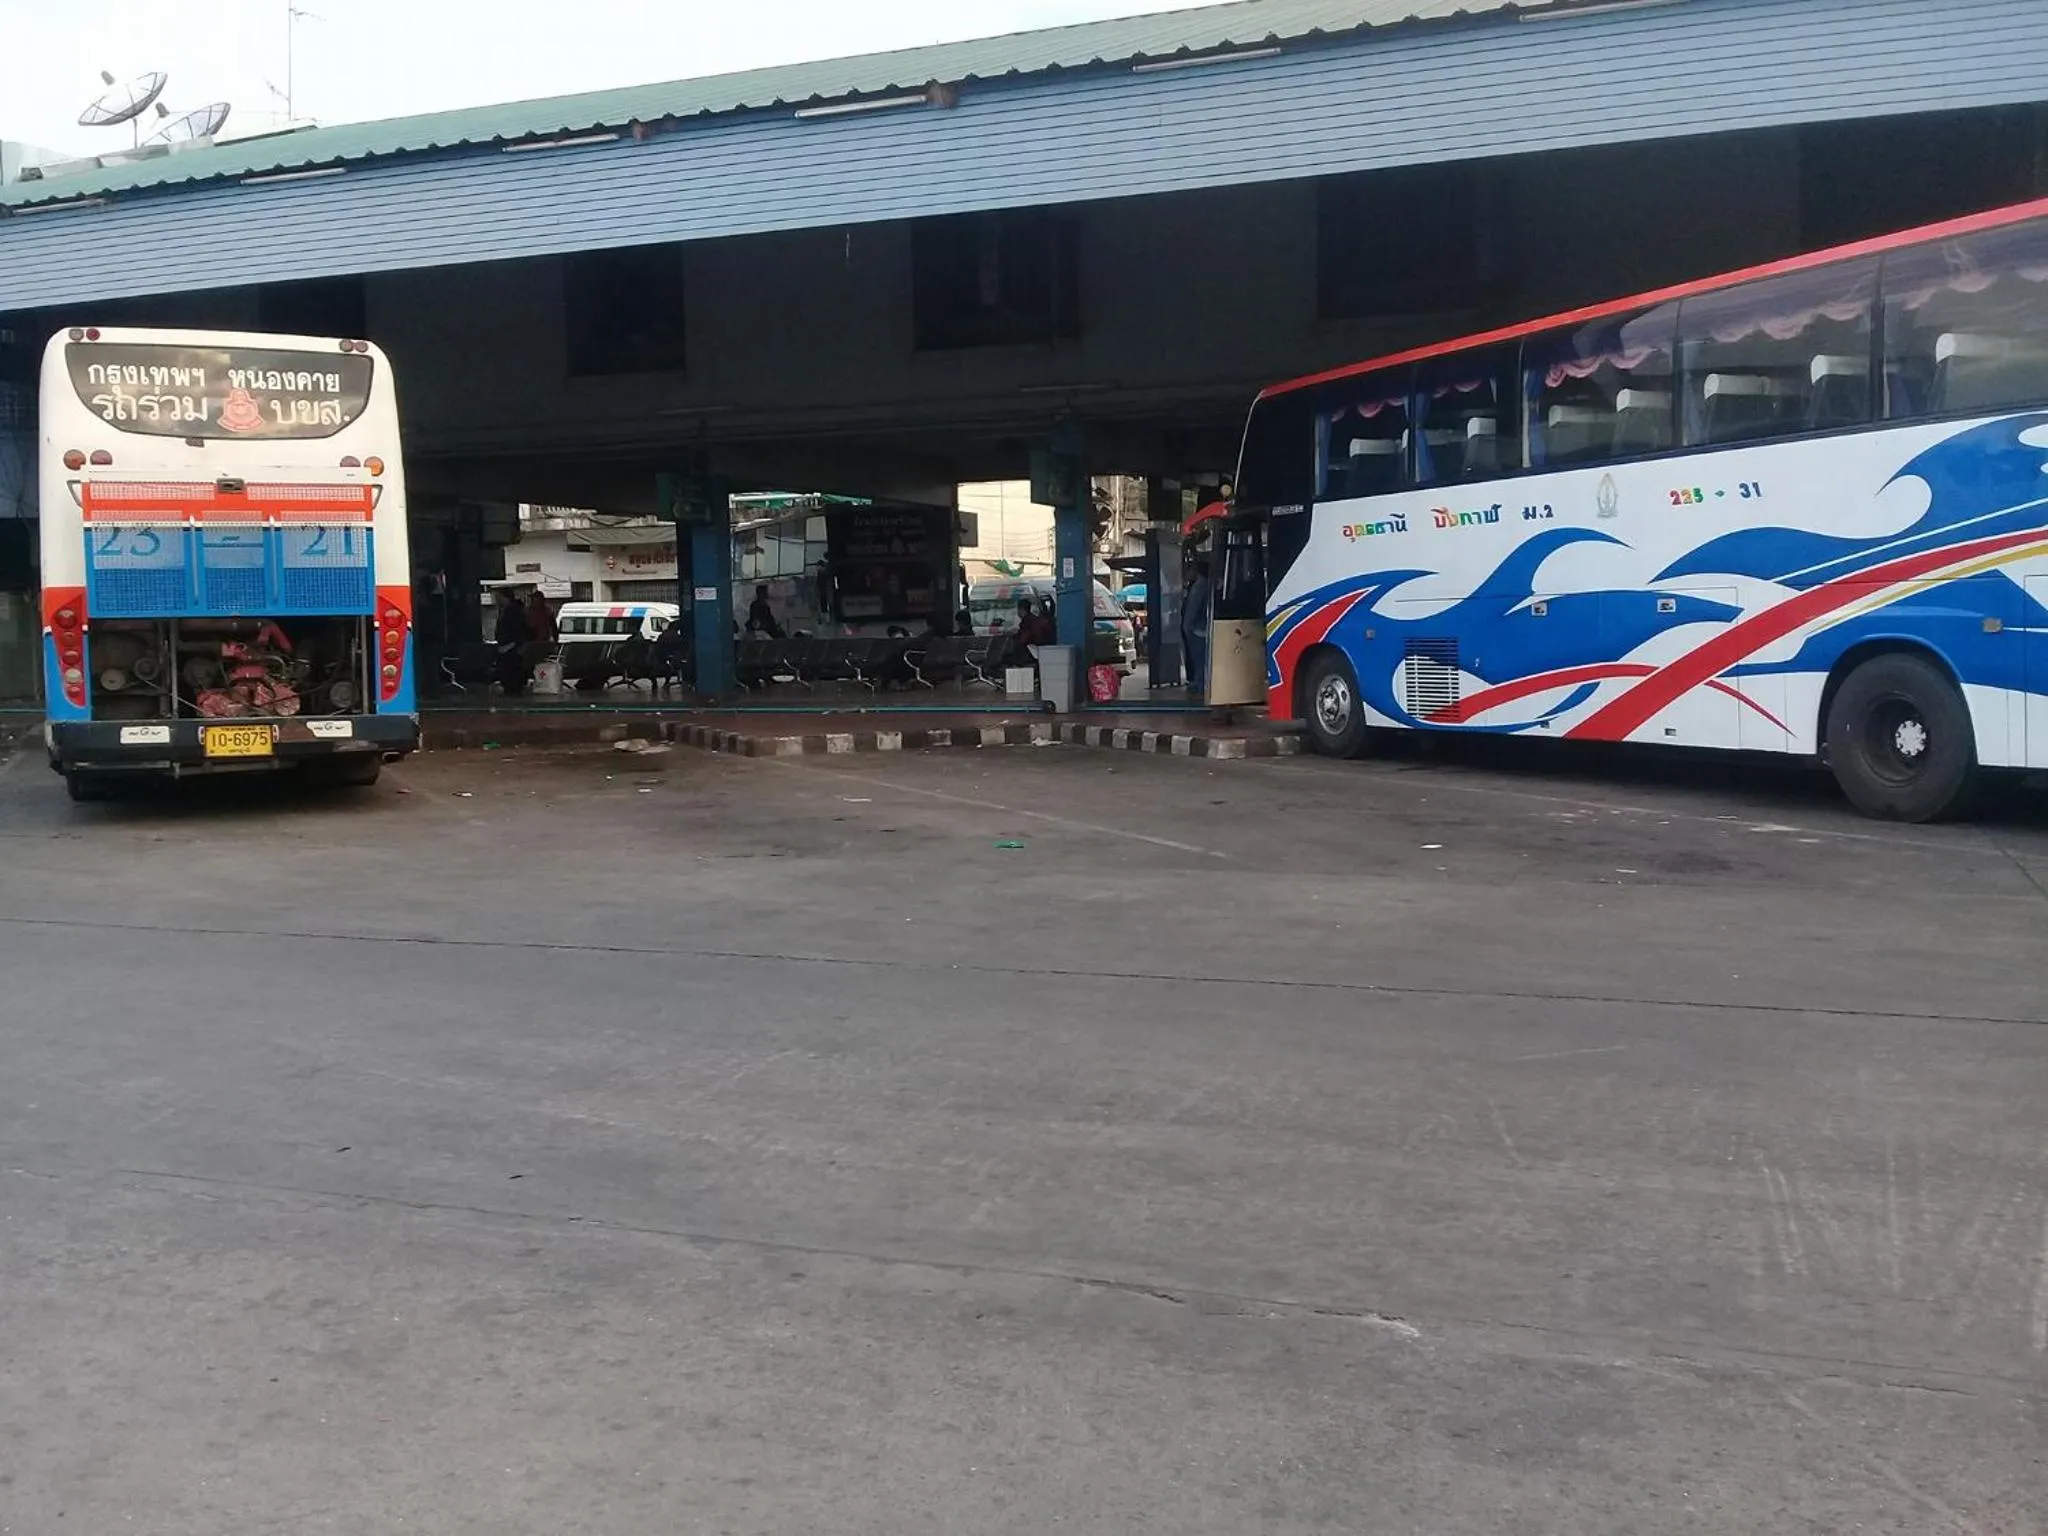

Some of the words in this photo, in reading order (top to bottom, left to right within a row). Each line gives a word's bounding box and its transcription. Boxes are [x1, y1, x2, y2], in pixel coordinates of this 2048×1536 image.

[87, 364, 206, 393] กรุงเทพฯ
[228, 368, 340, 392] หนองคาย
[92, 386, 208, 421] รถร่วม
[270, 399, 351, 425] บขส.
[1669, 487, 1704, 505] 225
[1738, 481, 1762, 499] 31
[1342, 512, 1409, 543] อุดรธานี
[1521, 504, 1554, 520] ม.2
[94, 525, 161, 556] 23
[301, 524, 356, 556] 21
[211, 731, 268, 747] 10-6975
